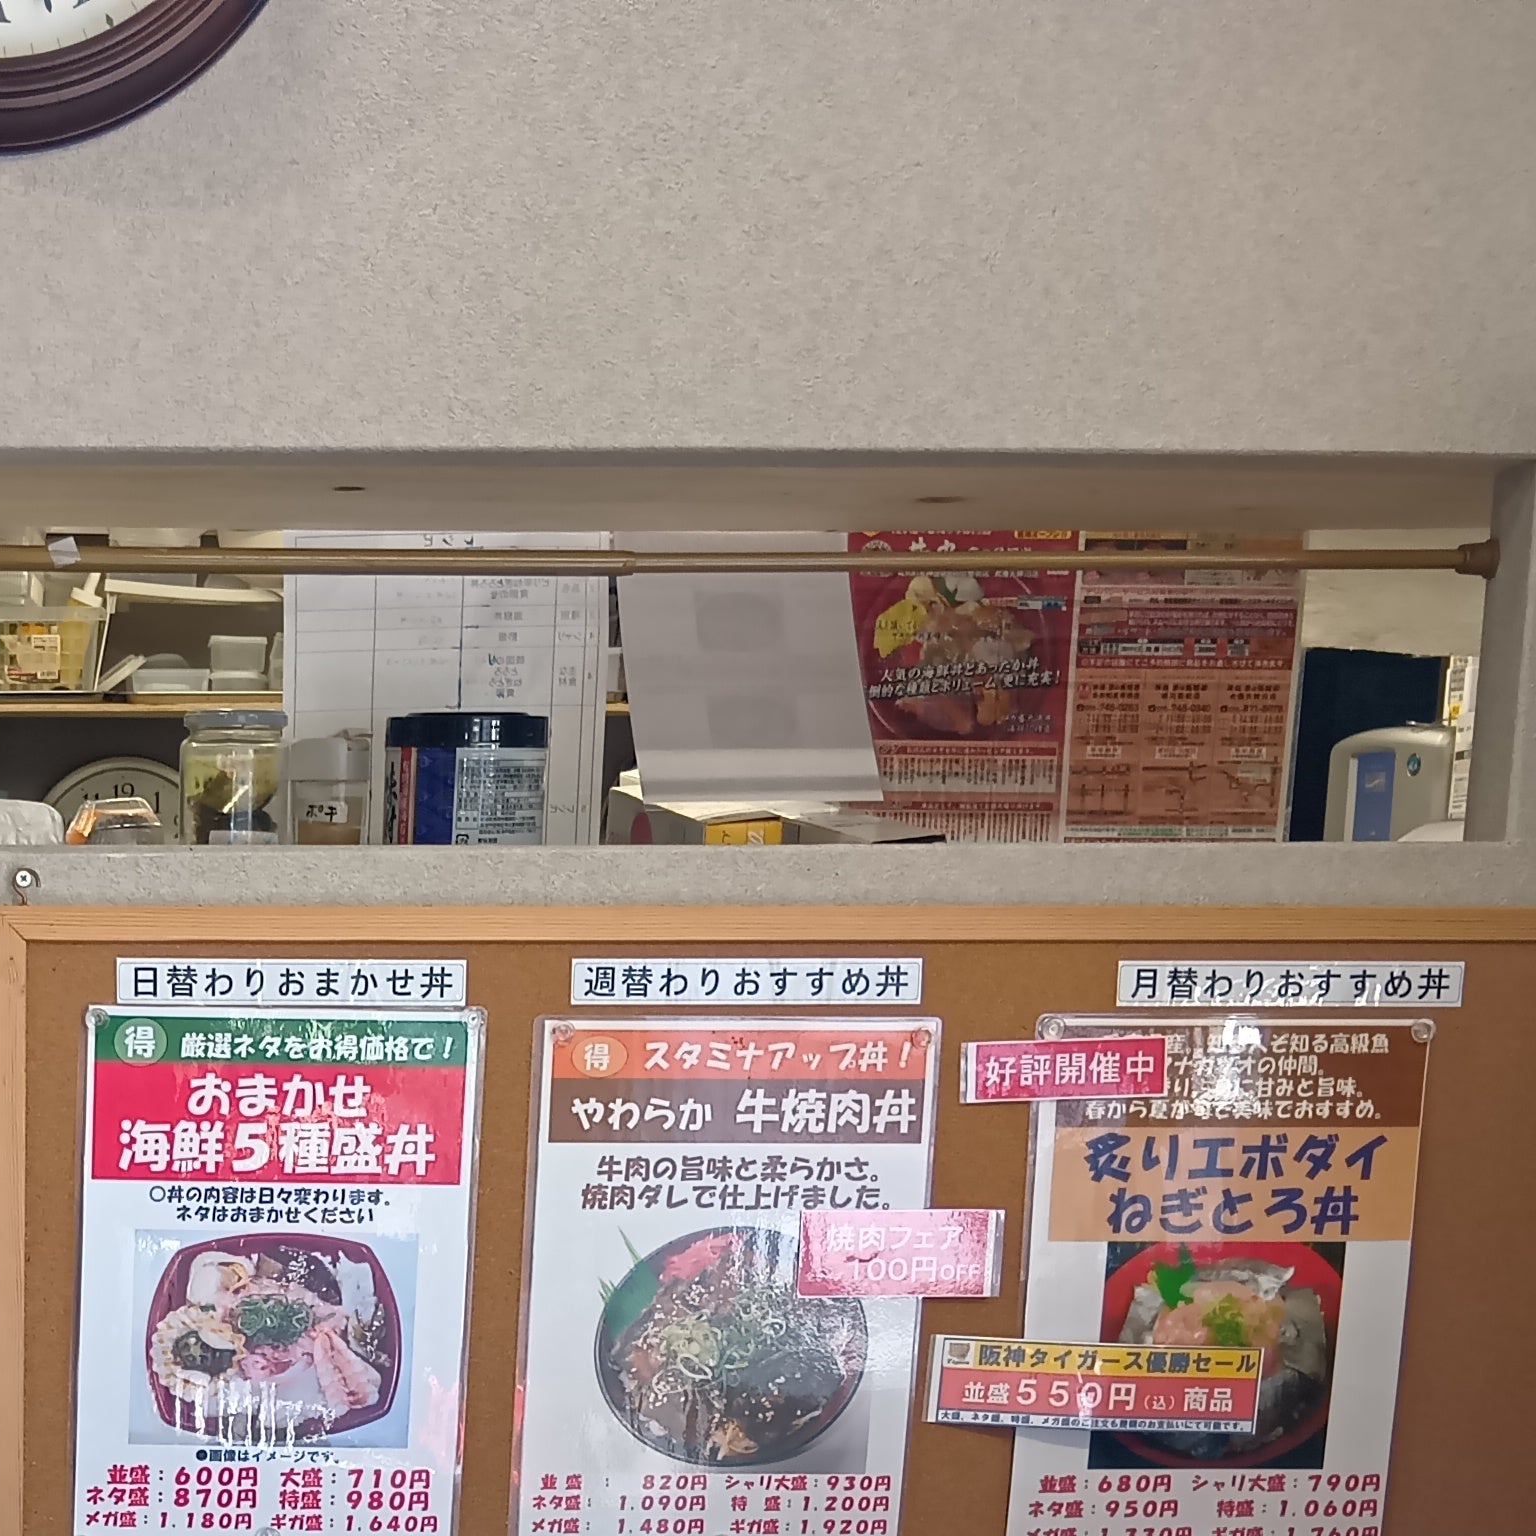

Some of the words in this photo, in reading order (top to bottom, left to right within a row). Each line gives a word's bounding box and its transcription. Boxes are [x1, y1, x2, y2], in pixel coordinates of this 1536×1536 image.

[132, 965, 454, 999] 日替わりおまかせ丼
[584, 965, 910, 999] 週替わりおすすめ丼
[1130, 968, 1452, 1001] 月替わりおすすめ丼
[124, 1026, 156, 1059] 得
[584, 1042, 611, 1071] 得
[985, 1049, 1156, 1087] 好評開催中
[189, 1074, 371, 1116] おまかせ
[571, 1099, 712, 1132] やわらか
[736, 1089, 917, 1135] 牛焼肉丼
[119, 1119, 435, 1176] 海鮮5種盛丼
[1084, 1133, 1389, 1183] 炙りエボダイ
[597, 1155, 879, 1183] 牛肉の旨味と柔らかさ。
[581, 1184, 891, 1211] 焼肉ダレで仕上げました。
[1107, 1186, 1359, 1236] ねぎとろ丼
[176, 1206, 375, 1225] ネタはおまかせください
[826, 1224, 963, 1251] 焼肉フェア
[978, 1345, 1256, 1374] 阪神タイガース優勝セール
